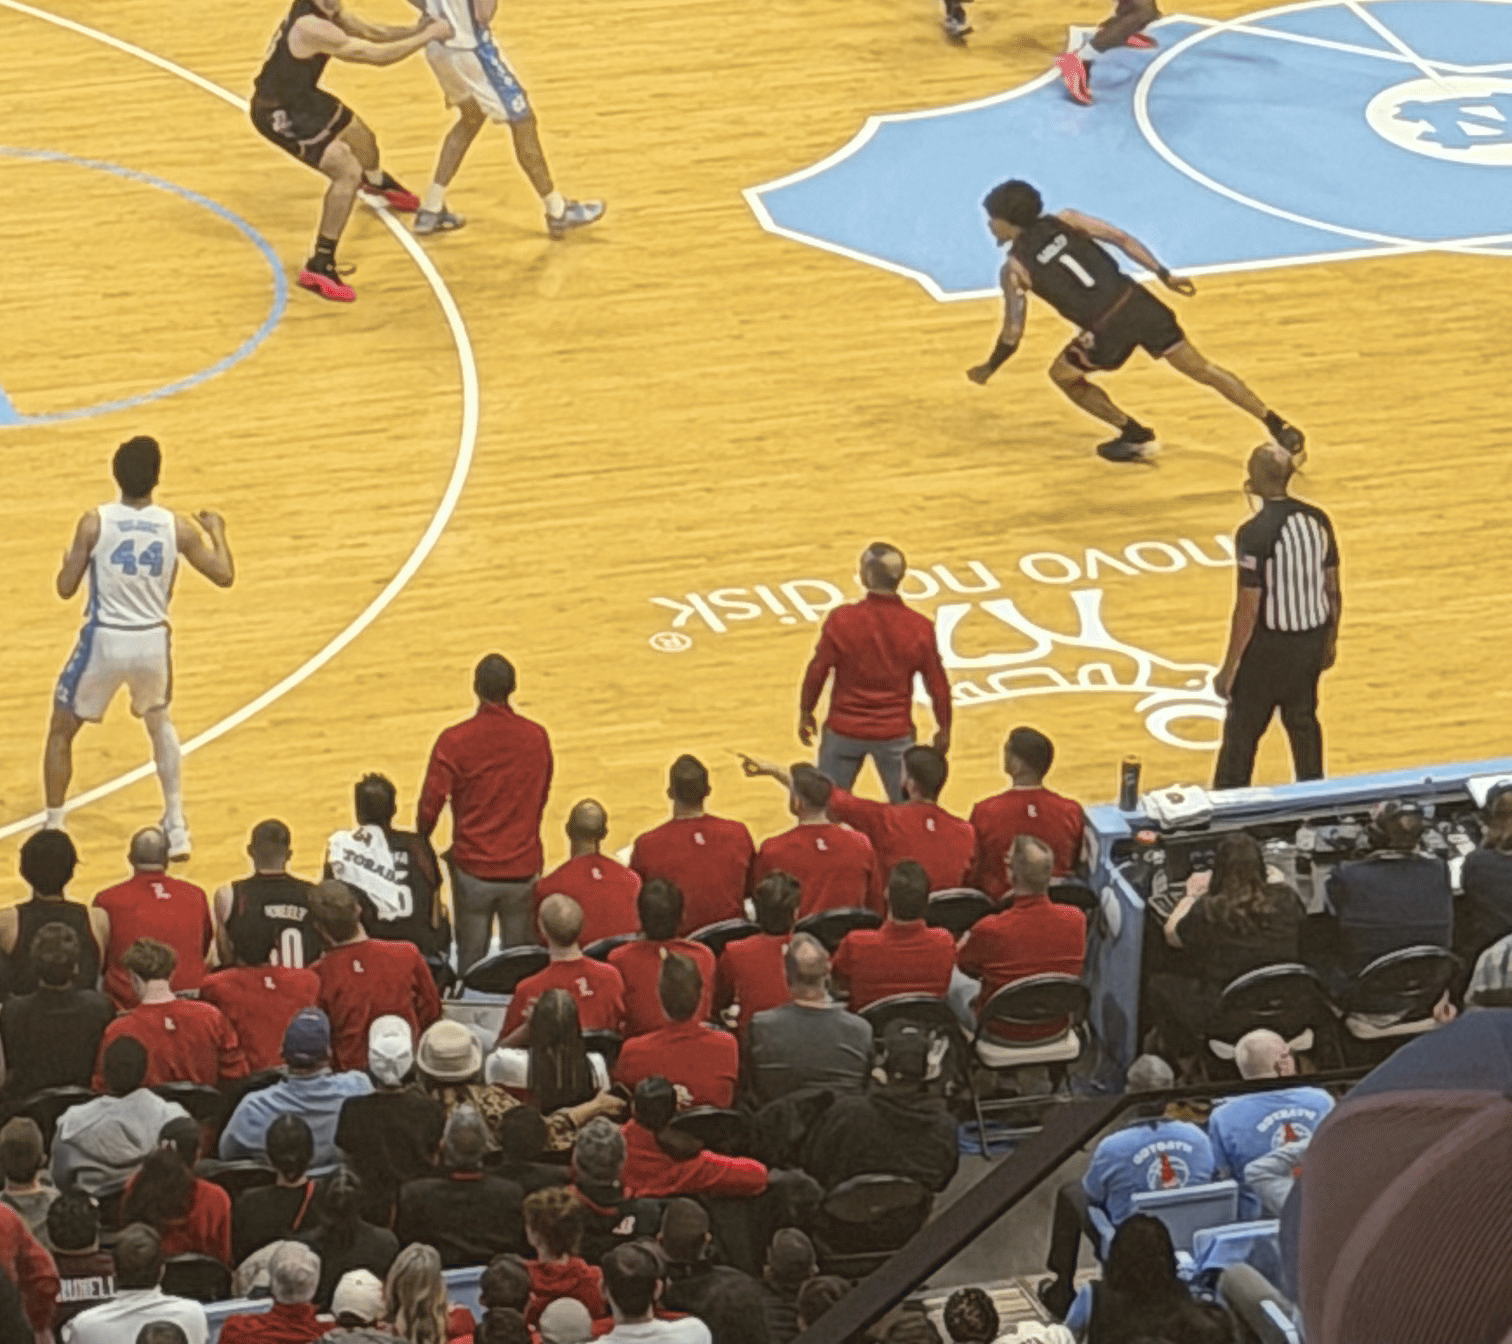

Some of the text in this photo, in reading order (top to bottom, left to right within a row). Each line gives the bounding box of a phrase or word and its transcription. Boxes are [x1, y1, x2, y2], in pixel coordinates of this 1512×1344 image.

[1059, 253, 1096, 288] 1
[110, 538, 164, 578] 44
[653, 560, 999, 633] nodisk
